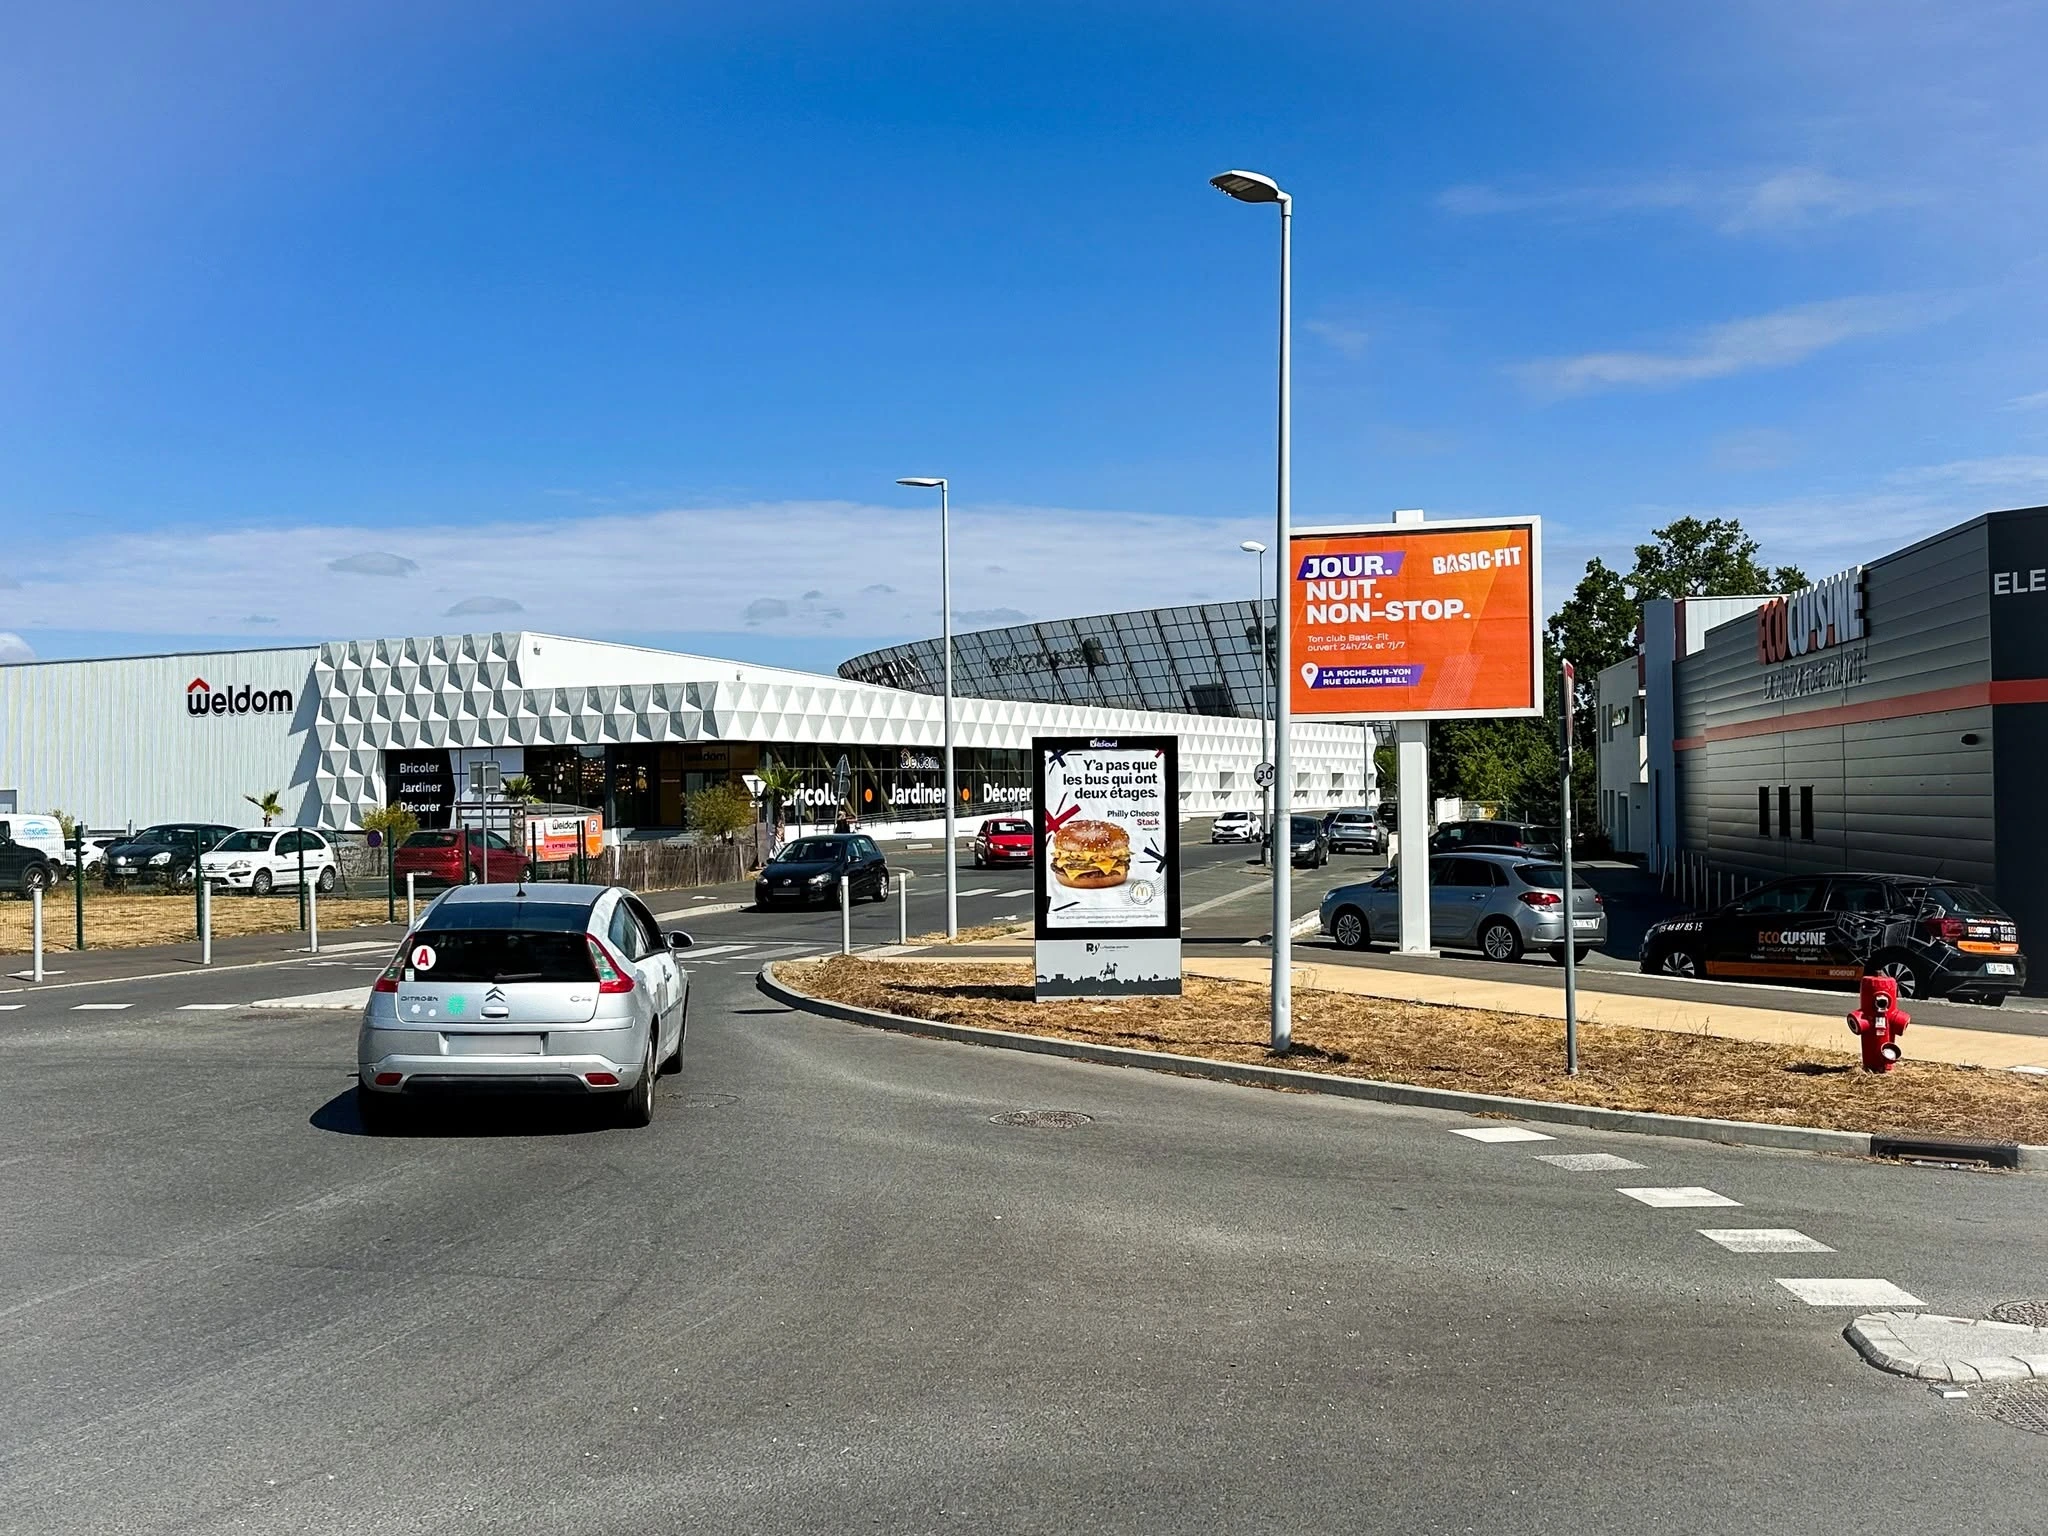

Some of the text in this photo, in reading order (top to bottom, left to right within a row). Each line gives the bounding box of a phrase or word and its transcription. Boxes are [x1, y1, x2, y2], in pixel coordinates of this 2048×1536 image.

[1305, 556, 1393, 578] JOUR.
[1432, 546, 1522, 575] BASIC-FIT
[1994, 568, 2046, 595] ELE
[1307, 578, 1383, 601] NUIT.
[1307, 599, 1471, 624] NON-STOP.
[1758, 566, 1864, 664] ECOCUISINE
[1308, 632, 1389, 643] Ton club Basic-Fit
[1308, 641, 1405, 652] ouvert 24h/24 et 7j/7
[1337, 668, 1411, 677] ROCHE-SUR-YON
[1344, 677, 1382, 685] GRAHAM
[1386, 676, 1408, 684] BELL
[187, 678, 293, 716] weldom
[400, 763, 440, 773] Bricoler
[1084, 760, 1157, 773] Y'a pas que
[1063, 773, 1157, 787] les bus qui ont
[1258, 770, 1273, 780] 30
[400, 782, 442, 792] Jardiner
[887, 782, 946, 805] Jardiner
[983, 782, 1032, 803] Décorer
[1074, 786, 1158, 801] deux étages.
[401, 802, 440, 812] Décorer
[1107, 810, 1129, 819] Philly
[1137, 818, 1160, 826] Stack
[1695, 922, 1703, 931] 15
[1758, 931, 1826, 945] ECOCUISINE
[417, 949, 429, 966] A
